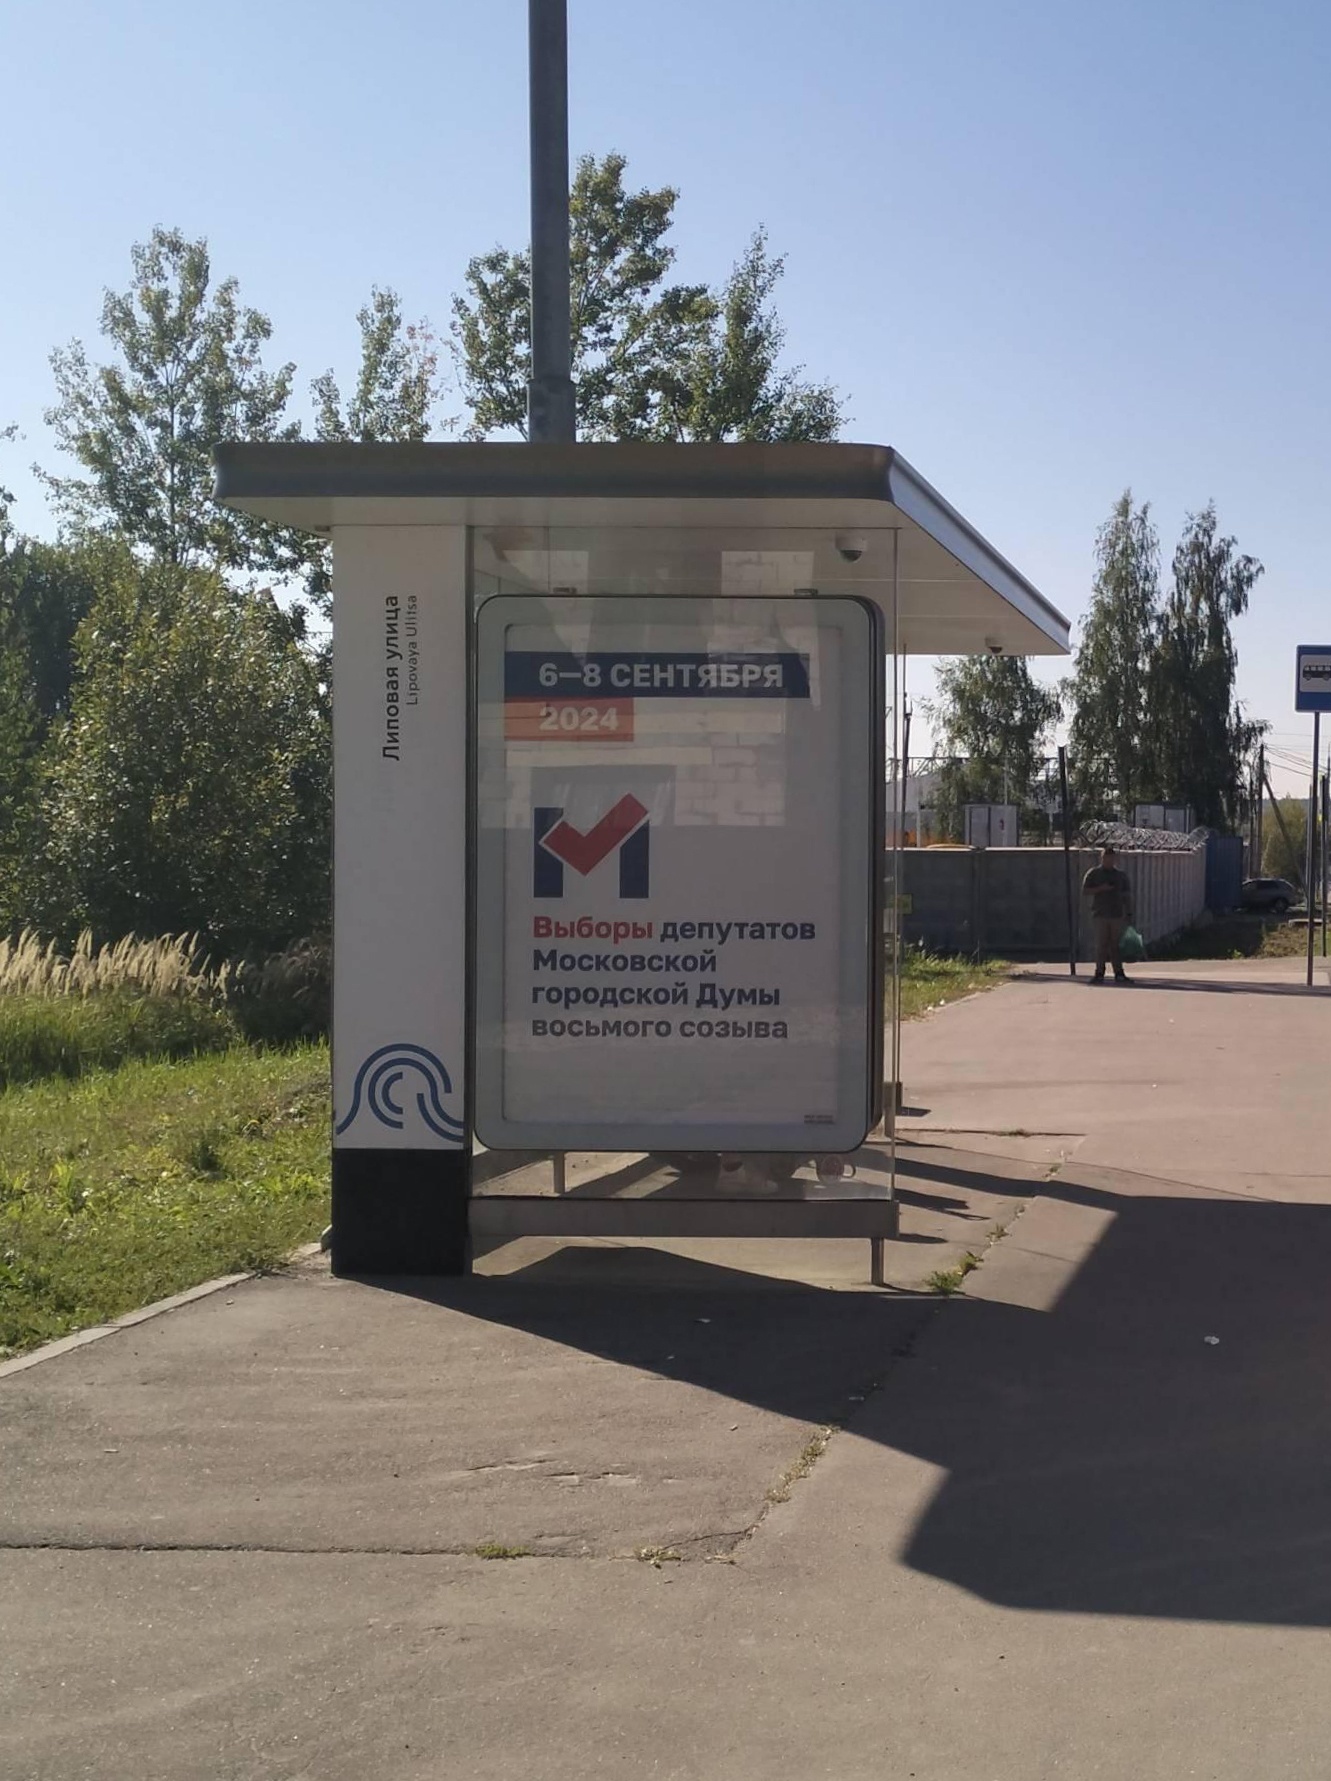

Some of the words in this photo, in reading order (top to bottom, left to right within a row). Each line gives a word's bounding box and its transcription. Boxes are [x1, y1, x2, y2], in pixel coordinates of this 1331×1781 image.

[385, 596, 403, 660] улица
[404, 595, 418, 637] Ulitsa
[406, 642, 420, 706] Lipovaya
[610, 663, 784, 689] СЕНТЯБРЯ
[382, 667, 400, 761] Липовая
[538, 706, 619, 732] 2024
[532, 915, 653, 945] Выборы
[659, 920, 816, 945] депутатов
[532, 948, 718, 973] Московской
[531, 981, 689, 1010] городской
[695, 982, 781, 1011] Думы
[531, 1018, 673, 1039] восьмого
[678, 1019, 789, 1040] созыва
